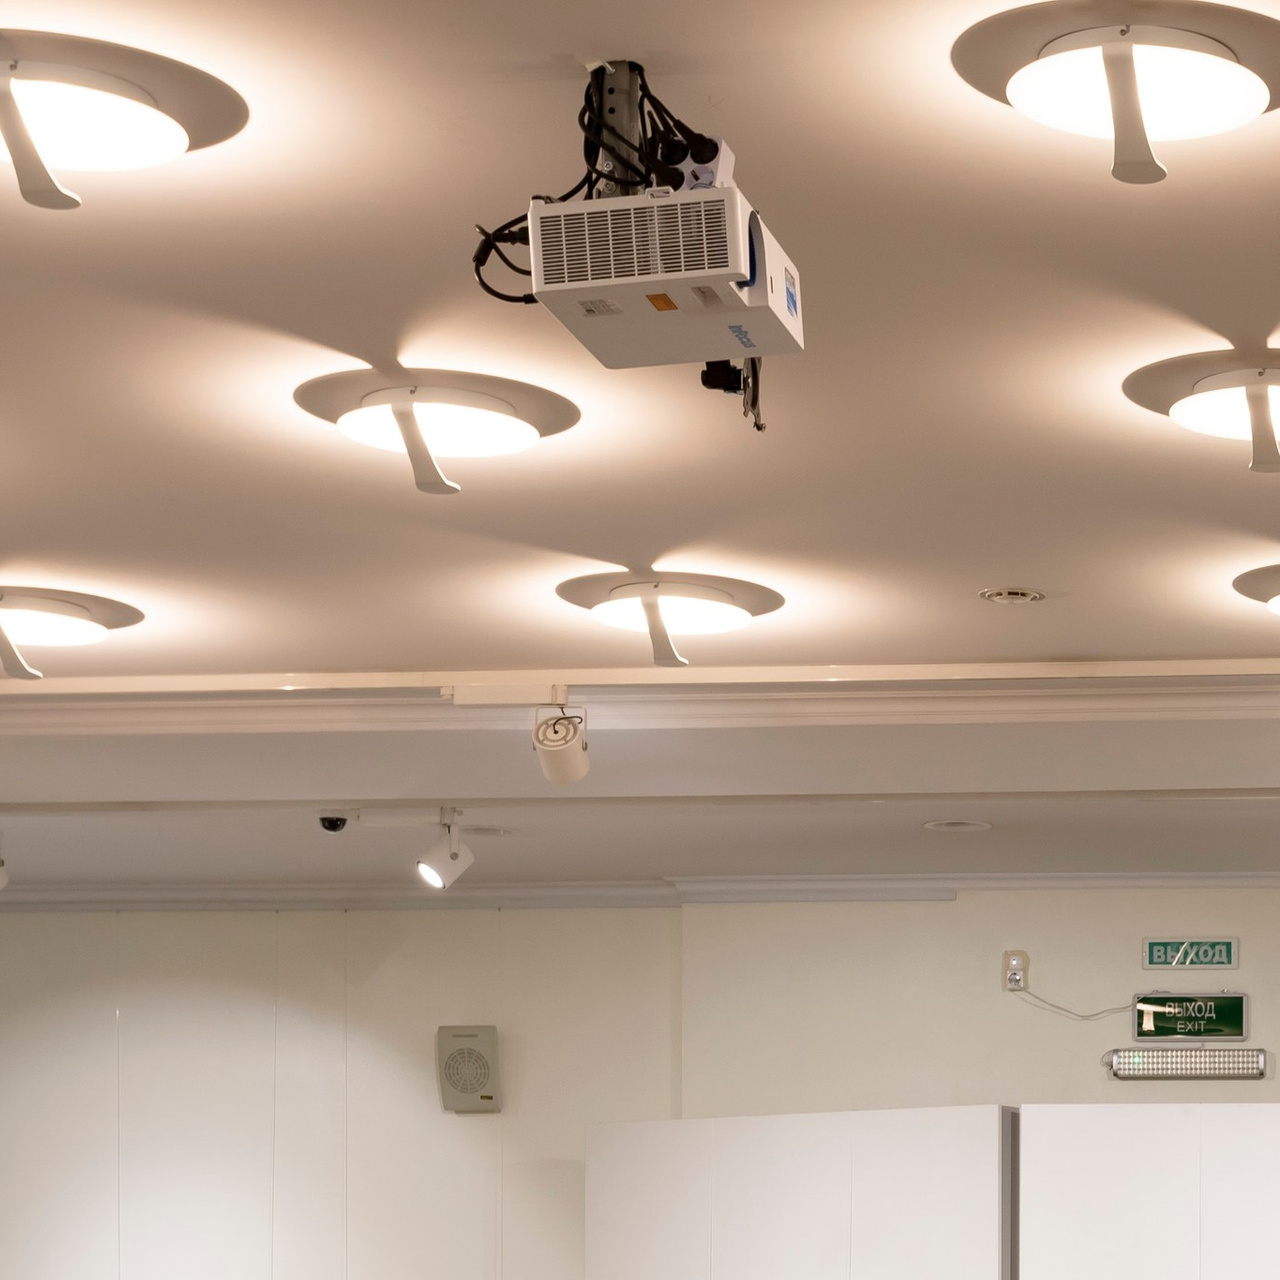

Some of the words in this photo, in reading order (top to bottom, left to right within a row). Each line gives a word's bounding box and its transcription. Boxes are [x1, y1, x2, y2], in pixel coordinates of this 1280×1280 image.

[1153, 945, 1228, 964] ВЫХОД
[1165, 1002, 1216, 1019] ВЫХОД
[1177, 1021, 1206, 1032] EXIT
